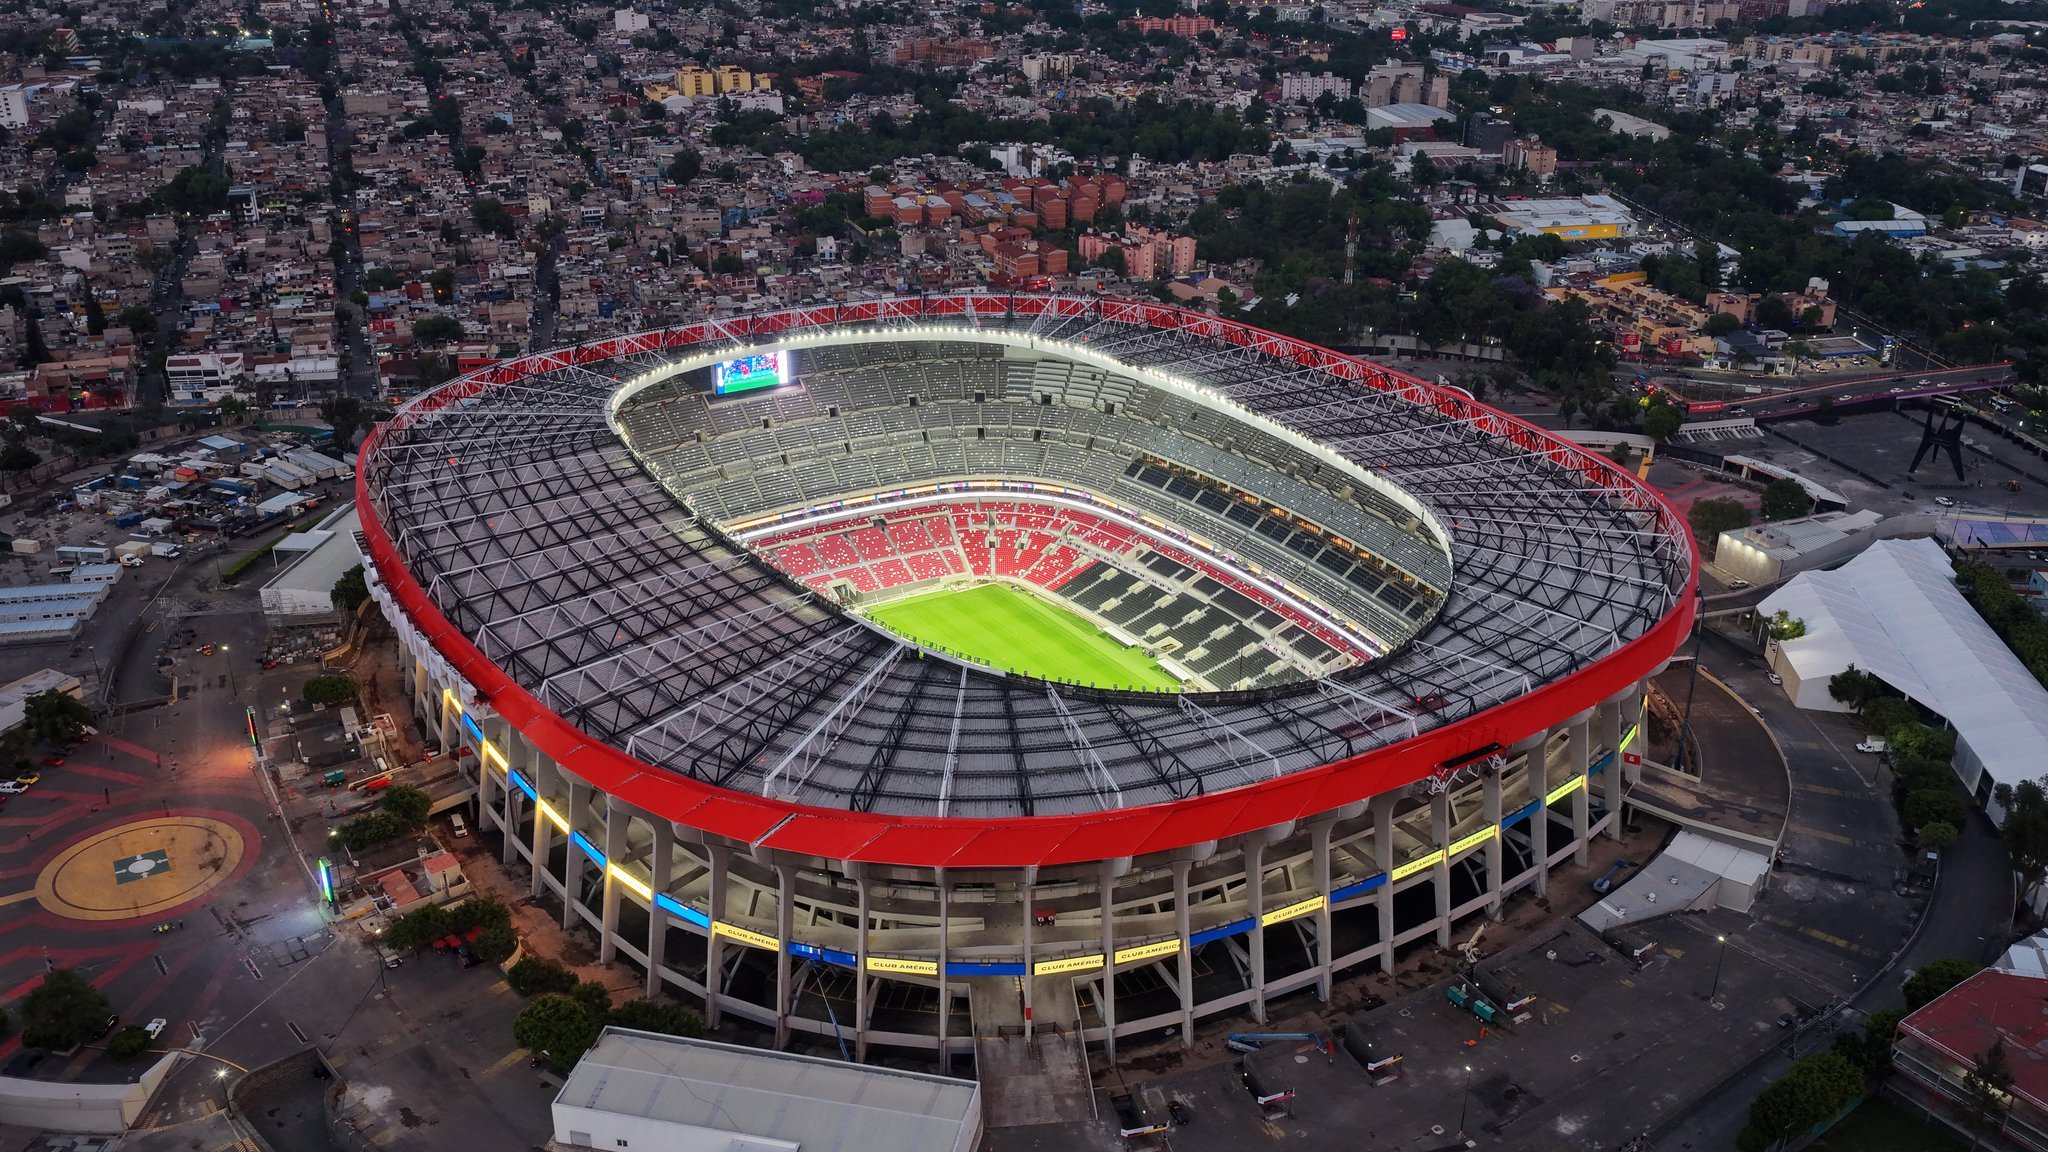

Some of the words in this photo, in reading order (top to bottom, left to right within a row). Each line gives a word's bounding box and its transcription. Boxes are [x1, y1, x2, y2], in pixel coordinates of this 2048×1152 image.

[1273, 910, 1293, 919] CLUB
[727, 929, 748, 938] CLUB
[749, 935, 778, 947] AMÉRIC
[1121, 951, 1143, 959] CLUB
